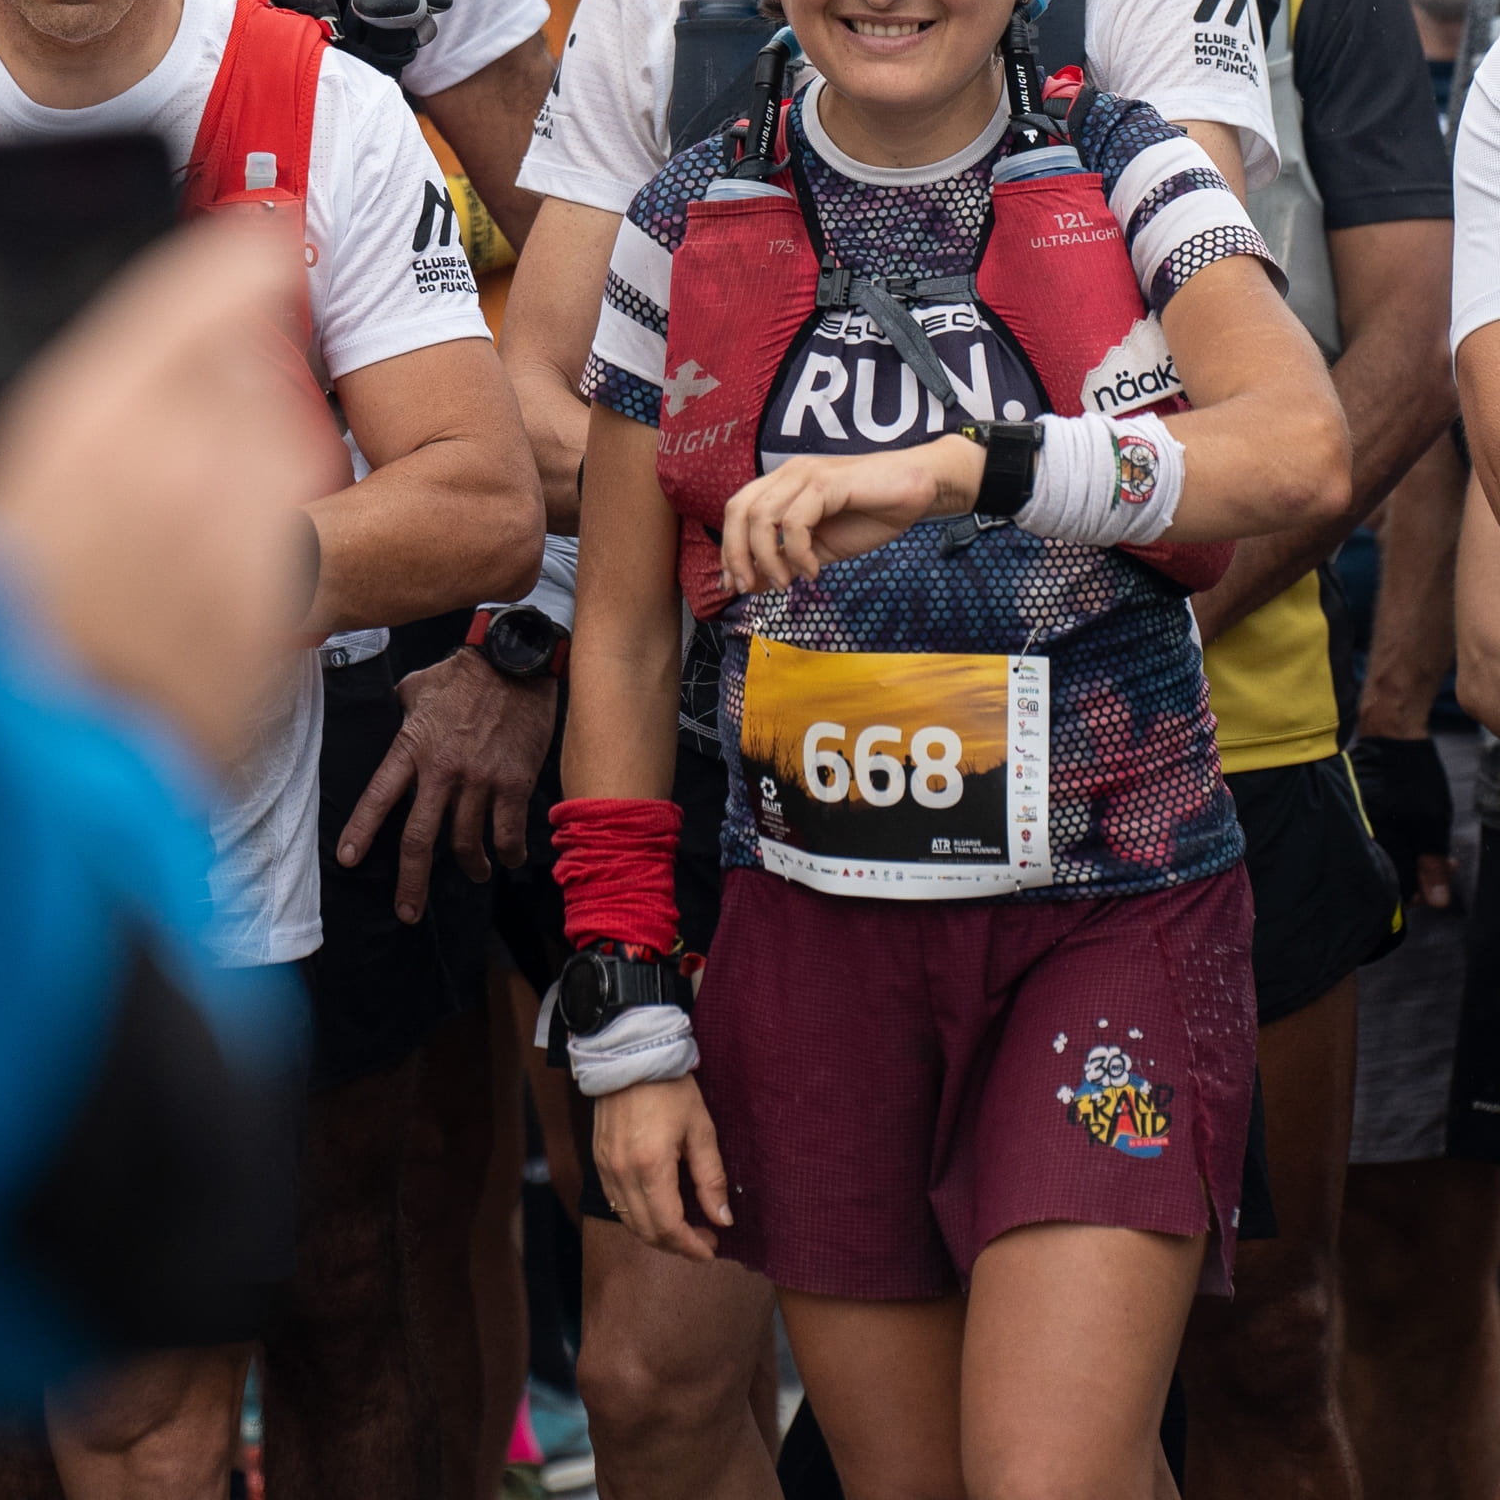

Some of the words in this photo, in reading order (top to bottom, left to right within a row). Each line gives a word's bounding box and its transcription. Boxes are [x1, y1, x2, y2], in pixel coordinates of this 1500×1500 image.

[1194, 32, 1237, 49] CLUBE
[1195, 57, 1212, 66] DO
[1016, 64, 1032, 116] AIDLIGHT
[759, 99, 776, 155] RAIDLIGHT
[1053, 211, 1094, 230] 12L
[1030, 227, 1120, 249] ULTRALIGHT
[412, 256, 457, 271] CLUBE
[419, 284, 436, 294] DO
[781, 341, 1027, 443] RUN.
[802, 721, 965, 810] 668
[931, 838, 953, 852] ATR
[1090, 1054, 1127, 1085] 30
[1067, 1083, 1175, 1126] GRAND
